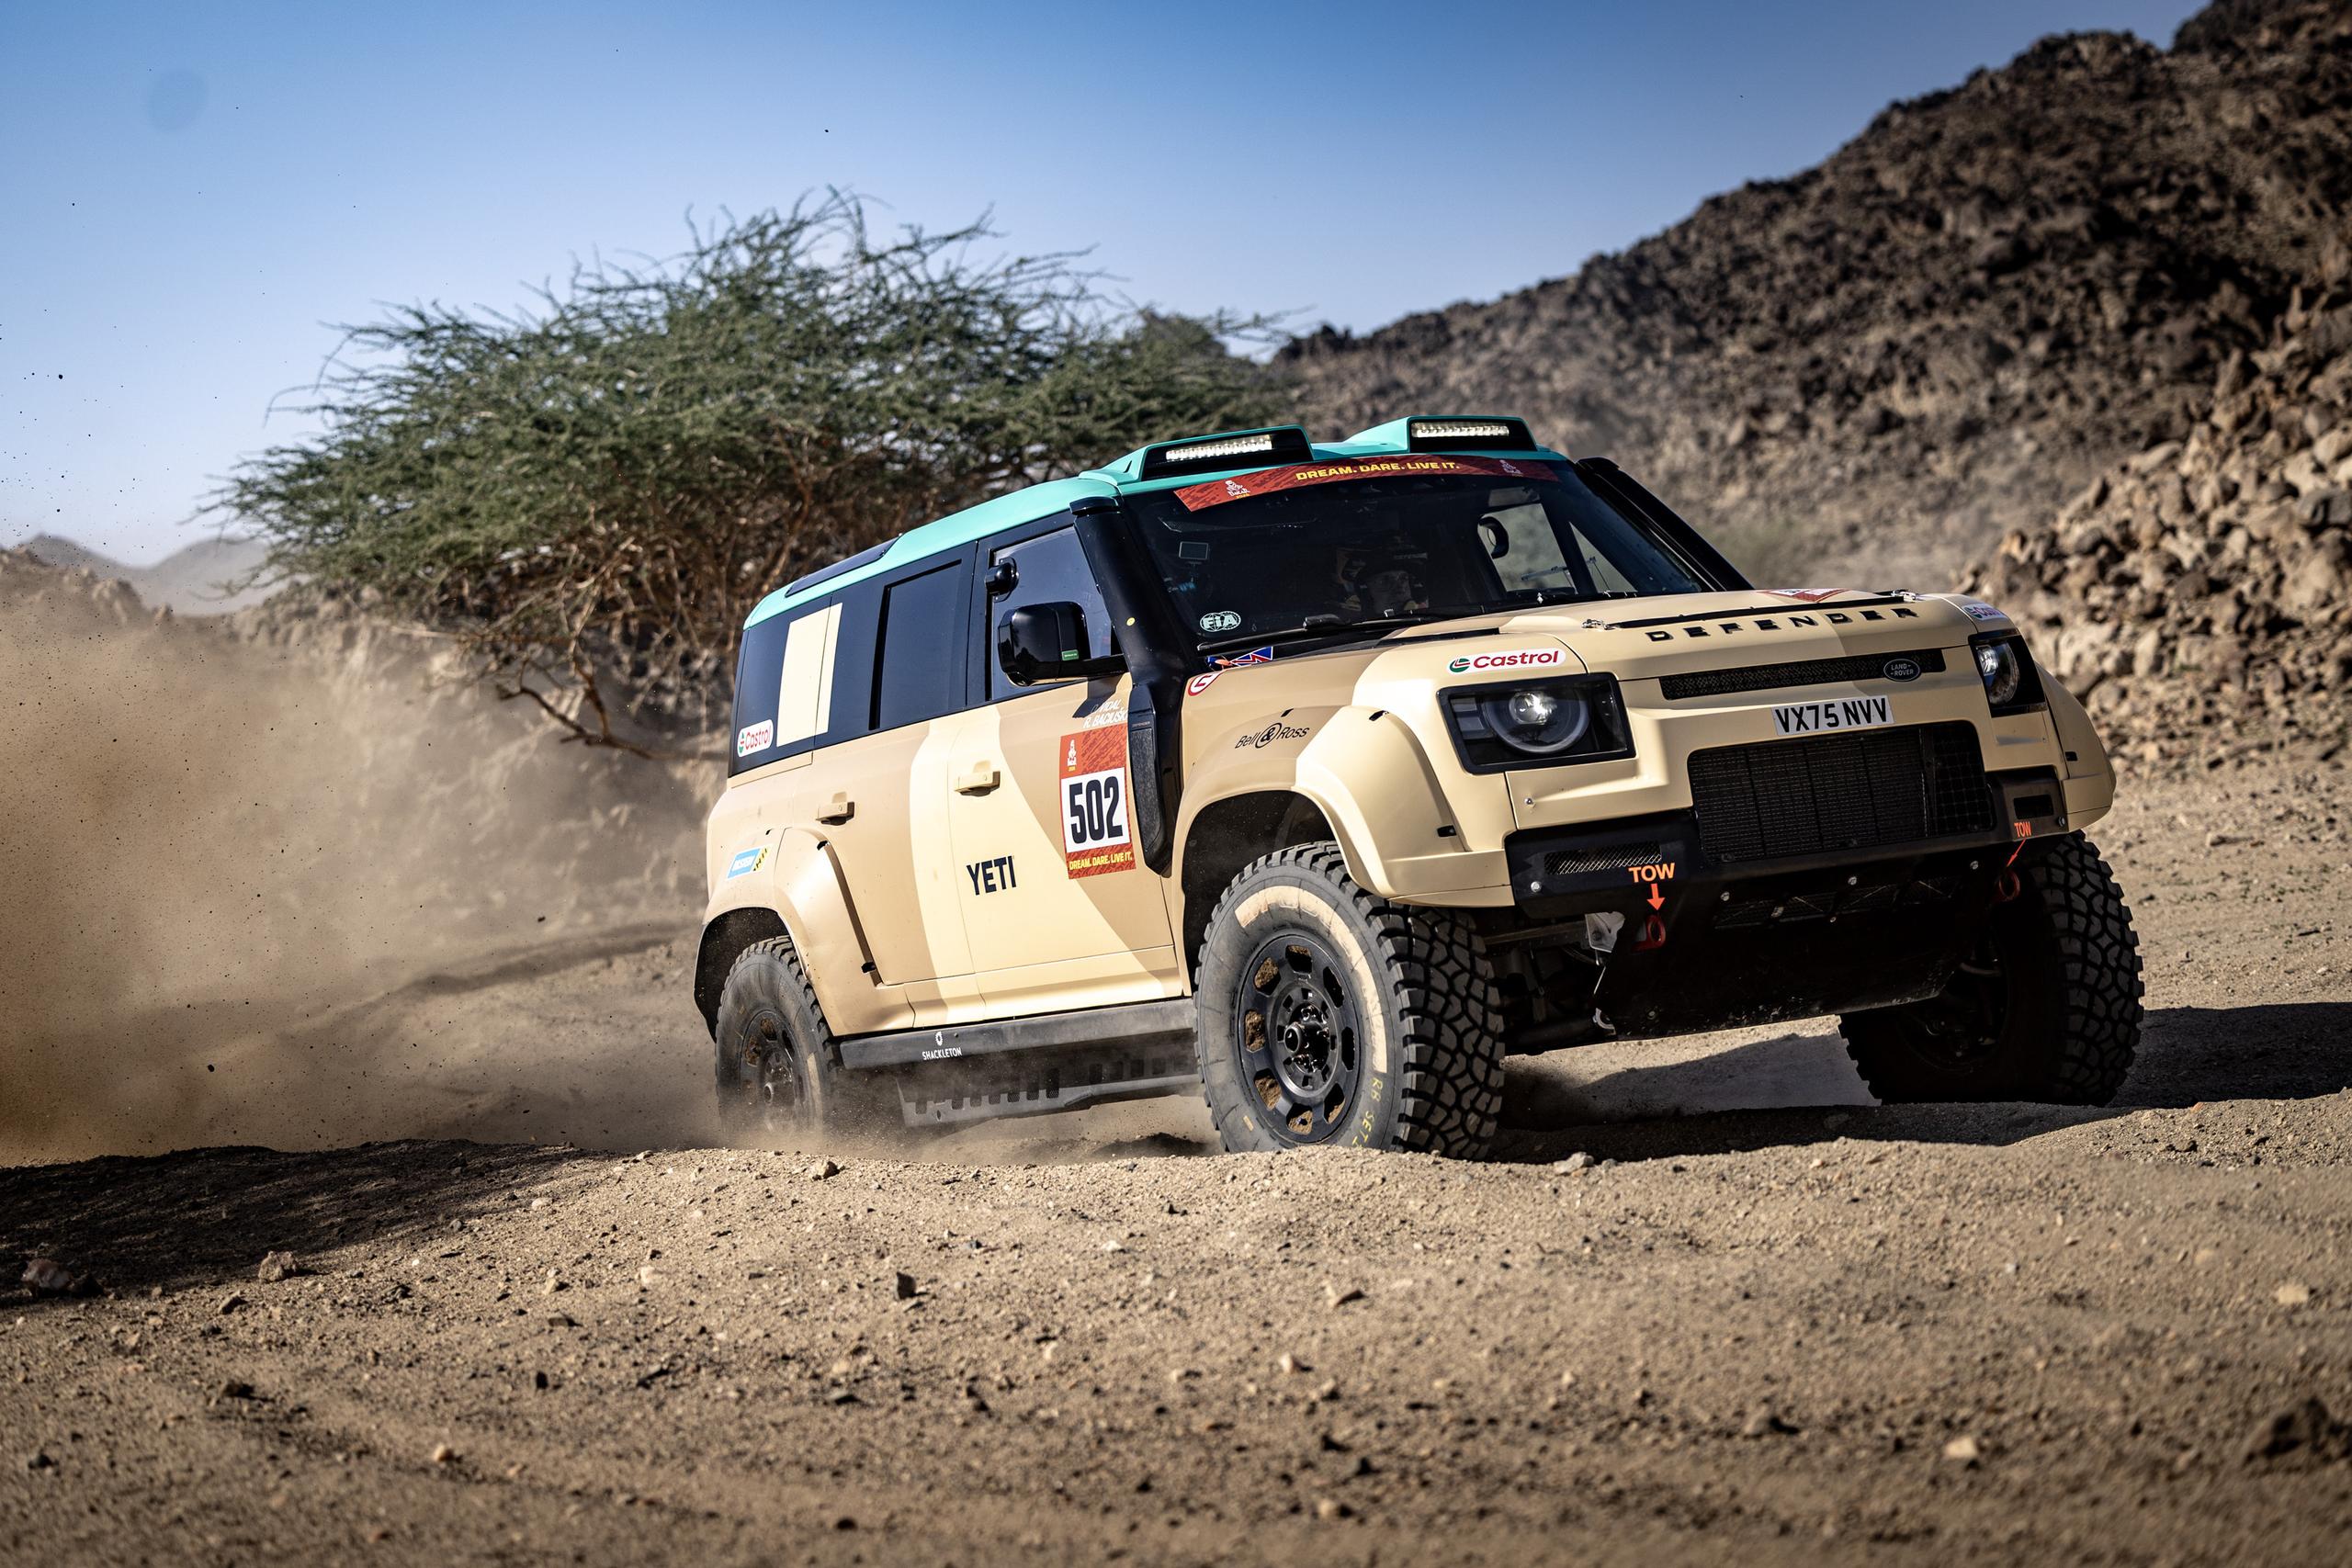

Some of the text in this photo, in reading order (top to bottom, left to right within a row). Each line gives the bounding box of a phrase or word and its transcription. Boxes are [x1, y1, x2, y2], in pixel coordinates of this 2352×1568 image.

[1295, 466, 1357, 480] DREAM.
[1360, 462, 1405, 473] DARE.
[1408, 462, 1441, 470] LIVE
[1643, 607, 1921, 642] DEFENDER
[1473, 650, 1559, 669] Castrol
[1775, 697, 1887, 733] VX75 NVV
[745, 724, 772, 750] Castrol
[1235, 731, 1261, 749] Bell
[1276, 727, 1310, 740] Ross
[1069, 775, 1124, 844] 502
[2013, 821, 2032, 838] TOW
[1069, 851, 1133, 871] DREAM. DARE. LIVE IT.
[966, 855, 1017, 897] YETI
[1627, 863, 1676, 883] TOW
[922, 1047, 963, 1061] SHACKLETON
